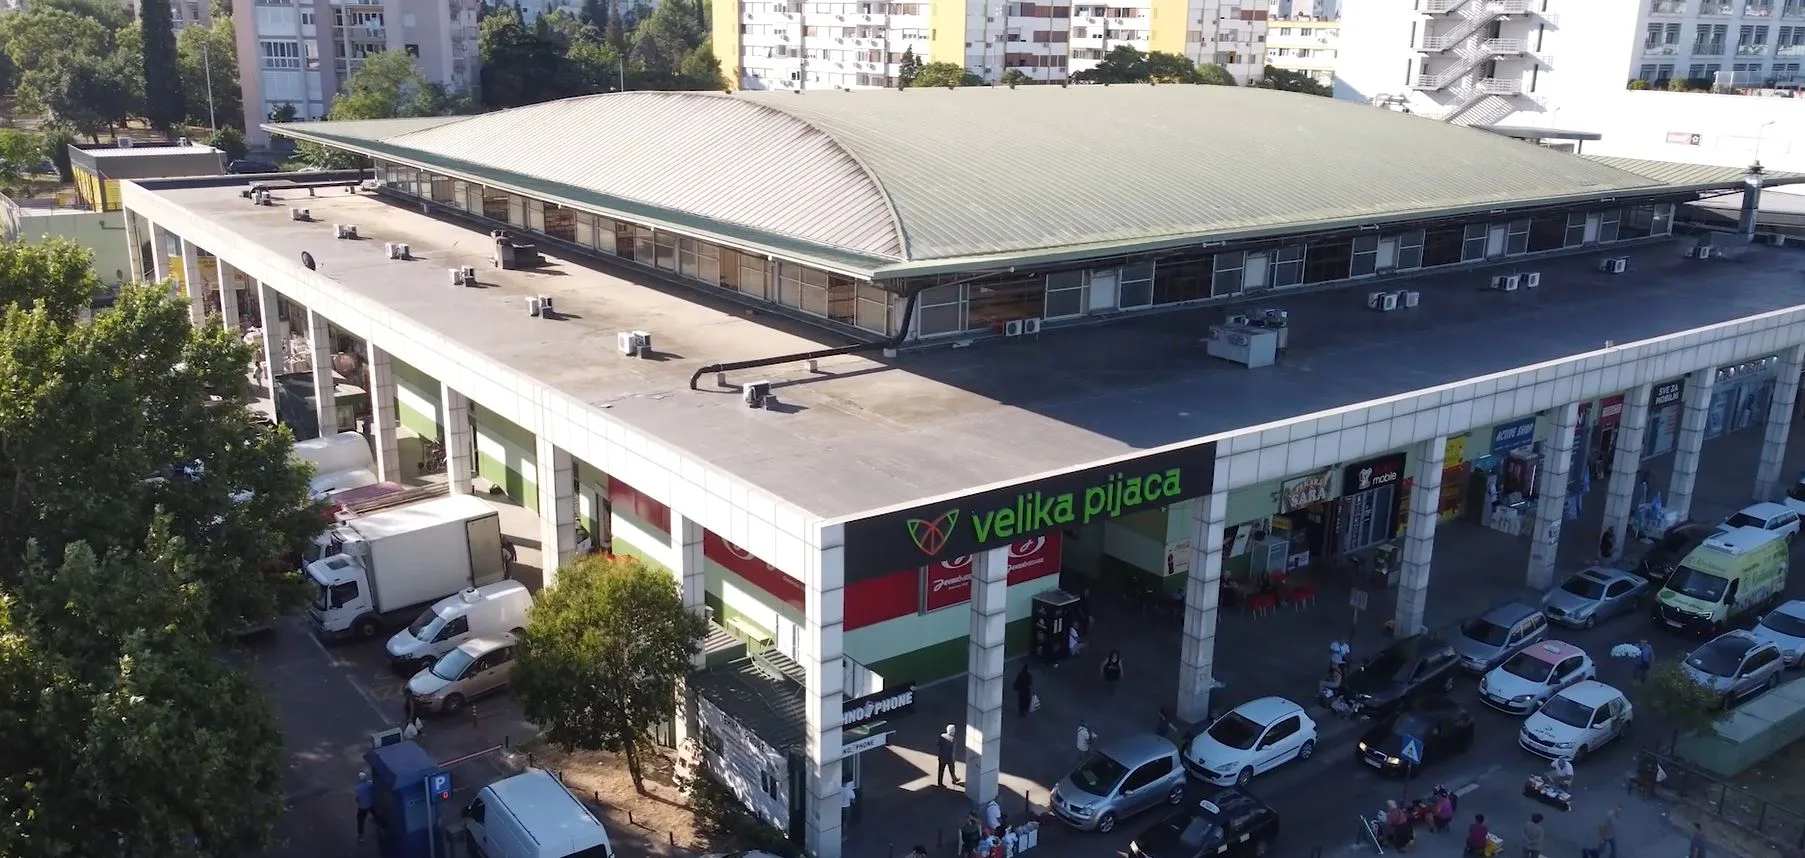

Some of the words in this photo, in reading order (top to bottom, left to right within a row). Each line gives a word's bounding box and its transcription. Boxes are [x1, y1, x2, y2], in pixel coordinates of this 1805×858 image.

[1658, 385, 1671, 396] SVE
[1670, 383, 1679, 393] ZA
[1496, 426, 1516, 442] ACTIVE
[1516, 422, 1535, 438] SHOP
[1372, 471, 1397, 485] mobile
[972, 491, 1075, 543] velika
[1083, 468, 1182, 524] pijaca
[1290, 487, 1326, 507] SARA
[873, 691, 913, 715] PHONE
[856, 740, 874, 751] PHONE
[435, 776, 446, 790] P
